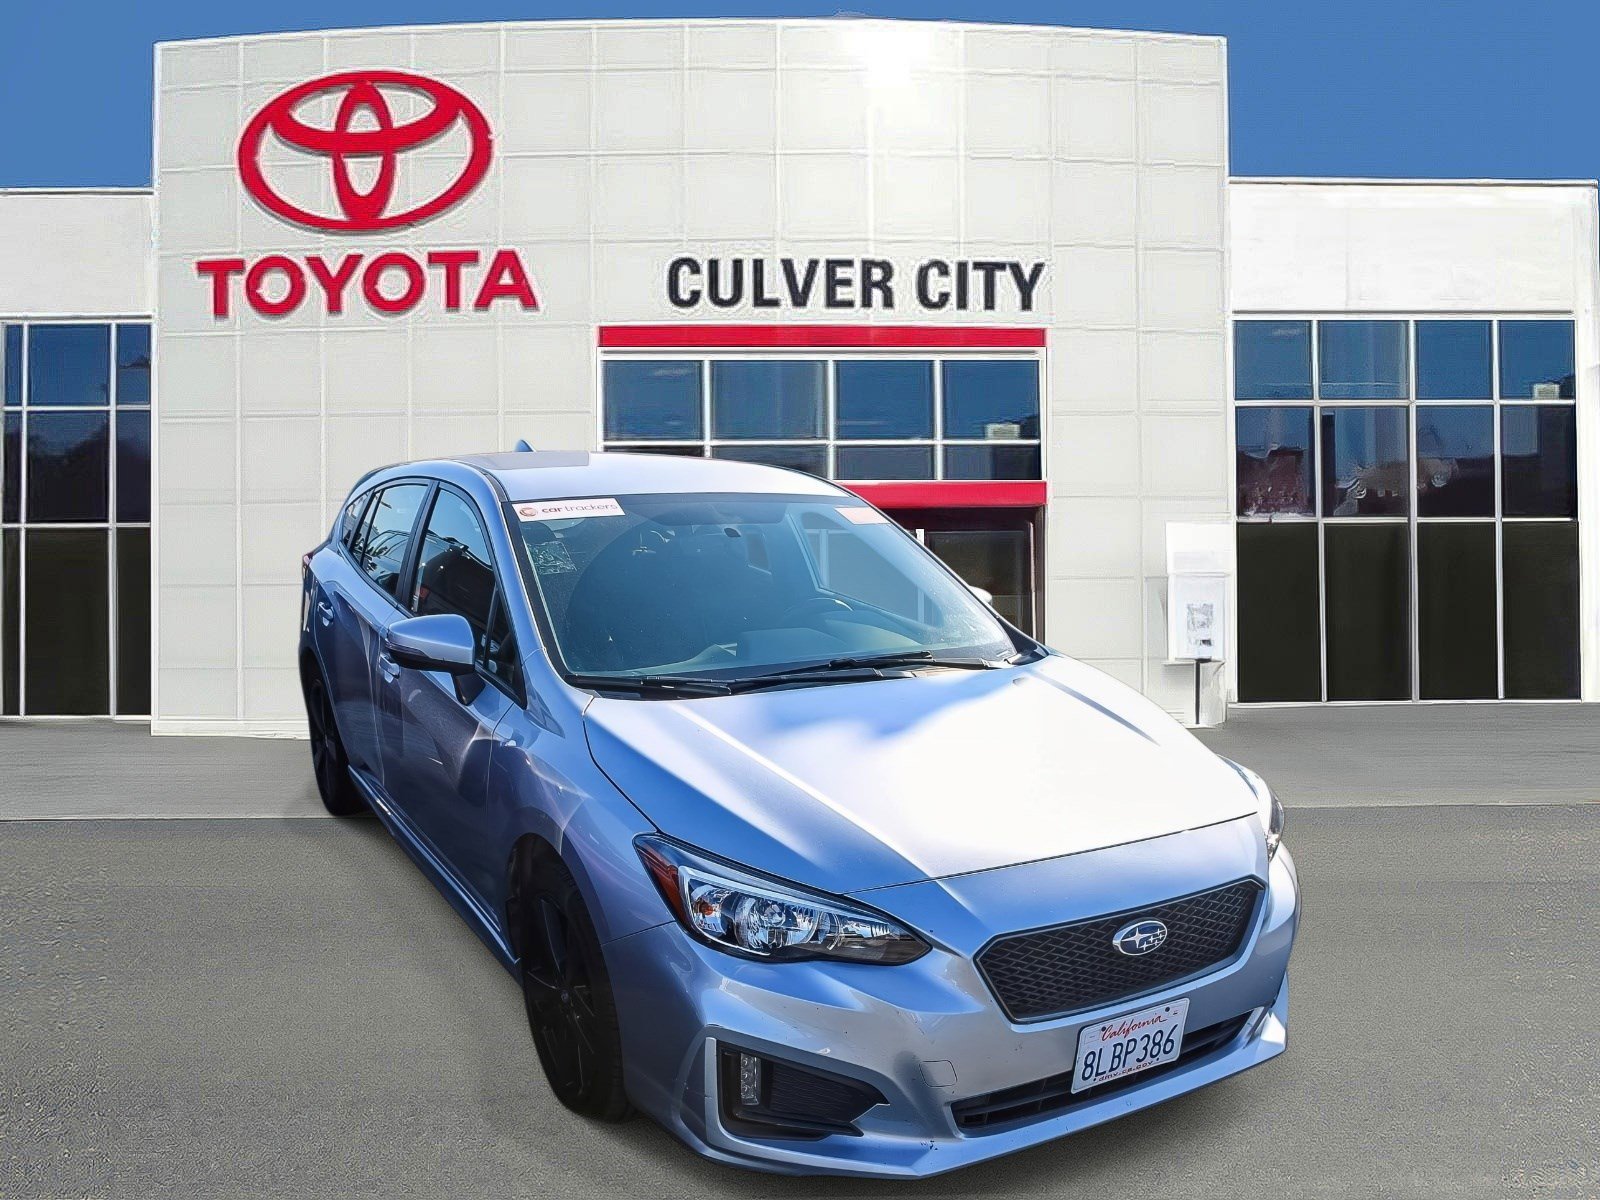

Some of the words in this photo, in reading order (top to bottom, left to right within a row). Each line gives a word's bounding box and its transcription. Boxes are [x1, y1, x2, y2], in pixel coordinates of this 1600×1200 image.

[196, 250, 540, 318] TOYOTA
[668, 257, 895, 309] CULVER
[915, 260, 1045, 311] CITY
[565, 502, 618, 512] trackers
[1081, 1023, 1179, 1082] 8LBP386
[1101, 1013, 1168, 1042] California
